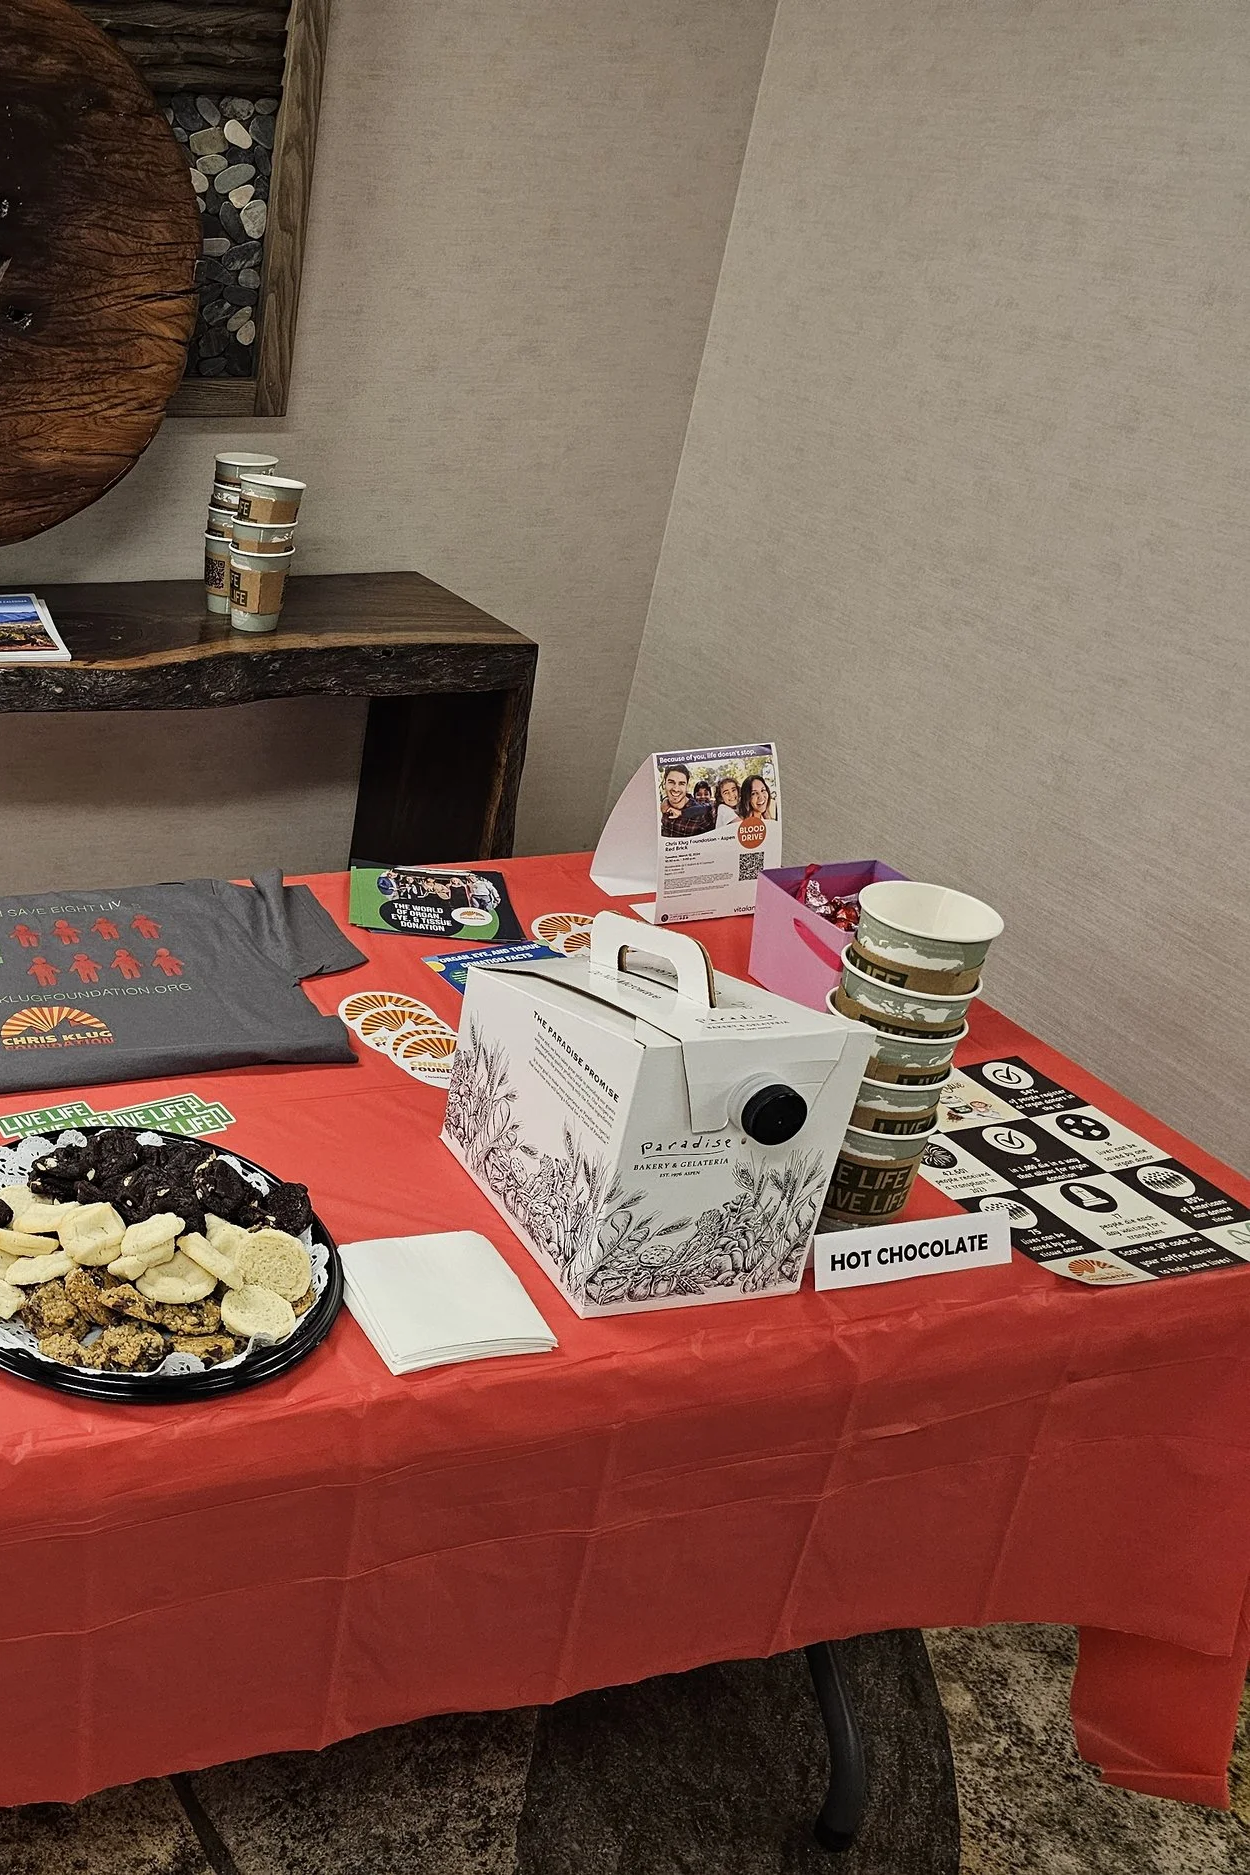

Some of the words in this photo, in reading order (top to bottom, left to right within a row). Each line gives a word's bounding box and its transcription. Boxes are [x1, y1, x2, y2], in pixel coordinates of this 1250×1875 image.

[693, 754, 707, 762] you,
[717, 750, 740, 758] doesn't
[740, 749, 756, 757] stop.
[740, 825, 765, 834] BLOOD
[678, 840, 689, 848] Klug
[741, 834, 764, 842] DRIVE
[7, 907, 47, 918] SAVE
[50, 902, 96, 914] EIGHT
[393, 902, 410, 911] THE
[412, 904, 444, 914] WORLD
[391, 914, 412, 922] EYE,
[421, 918, 452, 927] TISSUE
[410, 910, 443, 920] ORGAN,
[400, 921, 446, 932] DONATION
[438, 954, 472, 964] ORGAN,
[472, 950, 491, 961] EYE,
[492, 946, 510, 956] AND
[510, 942, 540, 954] TISSUE
[460, 956, 505, 968] DONATION
[506, 952, 533, 962] FACTS
[2, 1034, 58, 1046] CHRIS
[61, 1029, 114, 1042] KLUG
[533, 1010, 548, 1030] THE
[548, 1026, 584, 1067] PARADISE
[584, 1064, 620, 1103] PROMISE
[410, 1060, 451, 1068] CHRIS
[1018, 1094, 1040, 1103] people
[1040, 1089, 1066, 1098] register
[1025, 1100, 1044, 1108] organ
[1044, 1096, 1067, 1104] donors
[0, 1114, 46, 1132] LIVE
[46, 1103, 89, 1122] LIFE
[149, 1102, 192, 1122] LIFE
[176, 1114, 219, 1135] LIFE
[640, 1136, 732, 1155] Paradise
[633, 1162, 670, 1171] BAKERY
[680, 1158, 729, 1168] GELATERIA
[1104, 1154, 1125, 1162] saved
[858, 1168, 909, 1190] LIFE
[935, 1176, 959, 1186] people
[959, 1171, 991, 1181] received
[1046, 1172, 1078, 1182] donation
[952, 1180, 987, 1190] transplant
[868, 1189, 908, 1214] LIFE
[1190, 1199, 1228, 1212] Americans
[1207, 1206, 1233, 1216] donate
[1099, 1221, 1124, 1231] people
[1136, 1214, 1156, 1222] each
[1211, 1215, 1234, 1223] tissue
[1106, 1229, 1122, 1237] day
[1121, 1223, 1149, 1234] waiting
[1126, 1228, 1166, 1240] transplant
[1020, 1237, 1041, 1245] lives
[1030, 1242, 1053, 1252] saved
[1118, 1247, 1141, 1257] Scan
[1140, 1244, 1157, 1253] the
[1154, 1242, 1170, 1250] QR
[1168, 1238, 1190, 1247] code
[830, 1250, 872, 1272] HOT
[876, 1234, 988, 1265] CHOCOLATE
[1040, 1250, 1063, 1258] tissue
[1063, 1245, 1084, 1254] donor
[1139, 1259, 1160, 1268] your
[1160, 1252, 1190, 1263] coffee
[1189, 1247, 1217, 1257] sleeve
[1158, 1266, 1170, 1275] to
[1169, 1263, 1190, 1273] help
[1189, 1261, 1210, 1270] save
[1207, 1256, 1234, 1267] lives!
